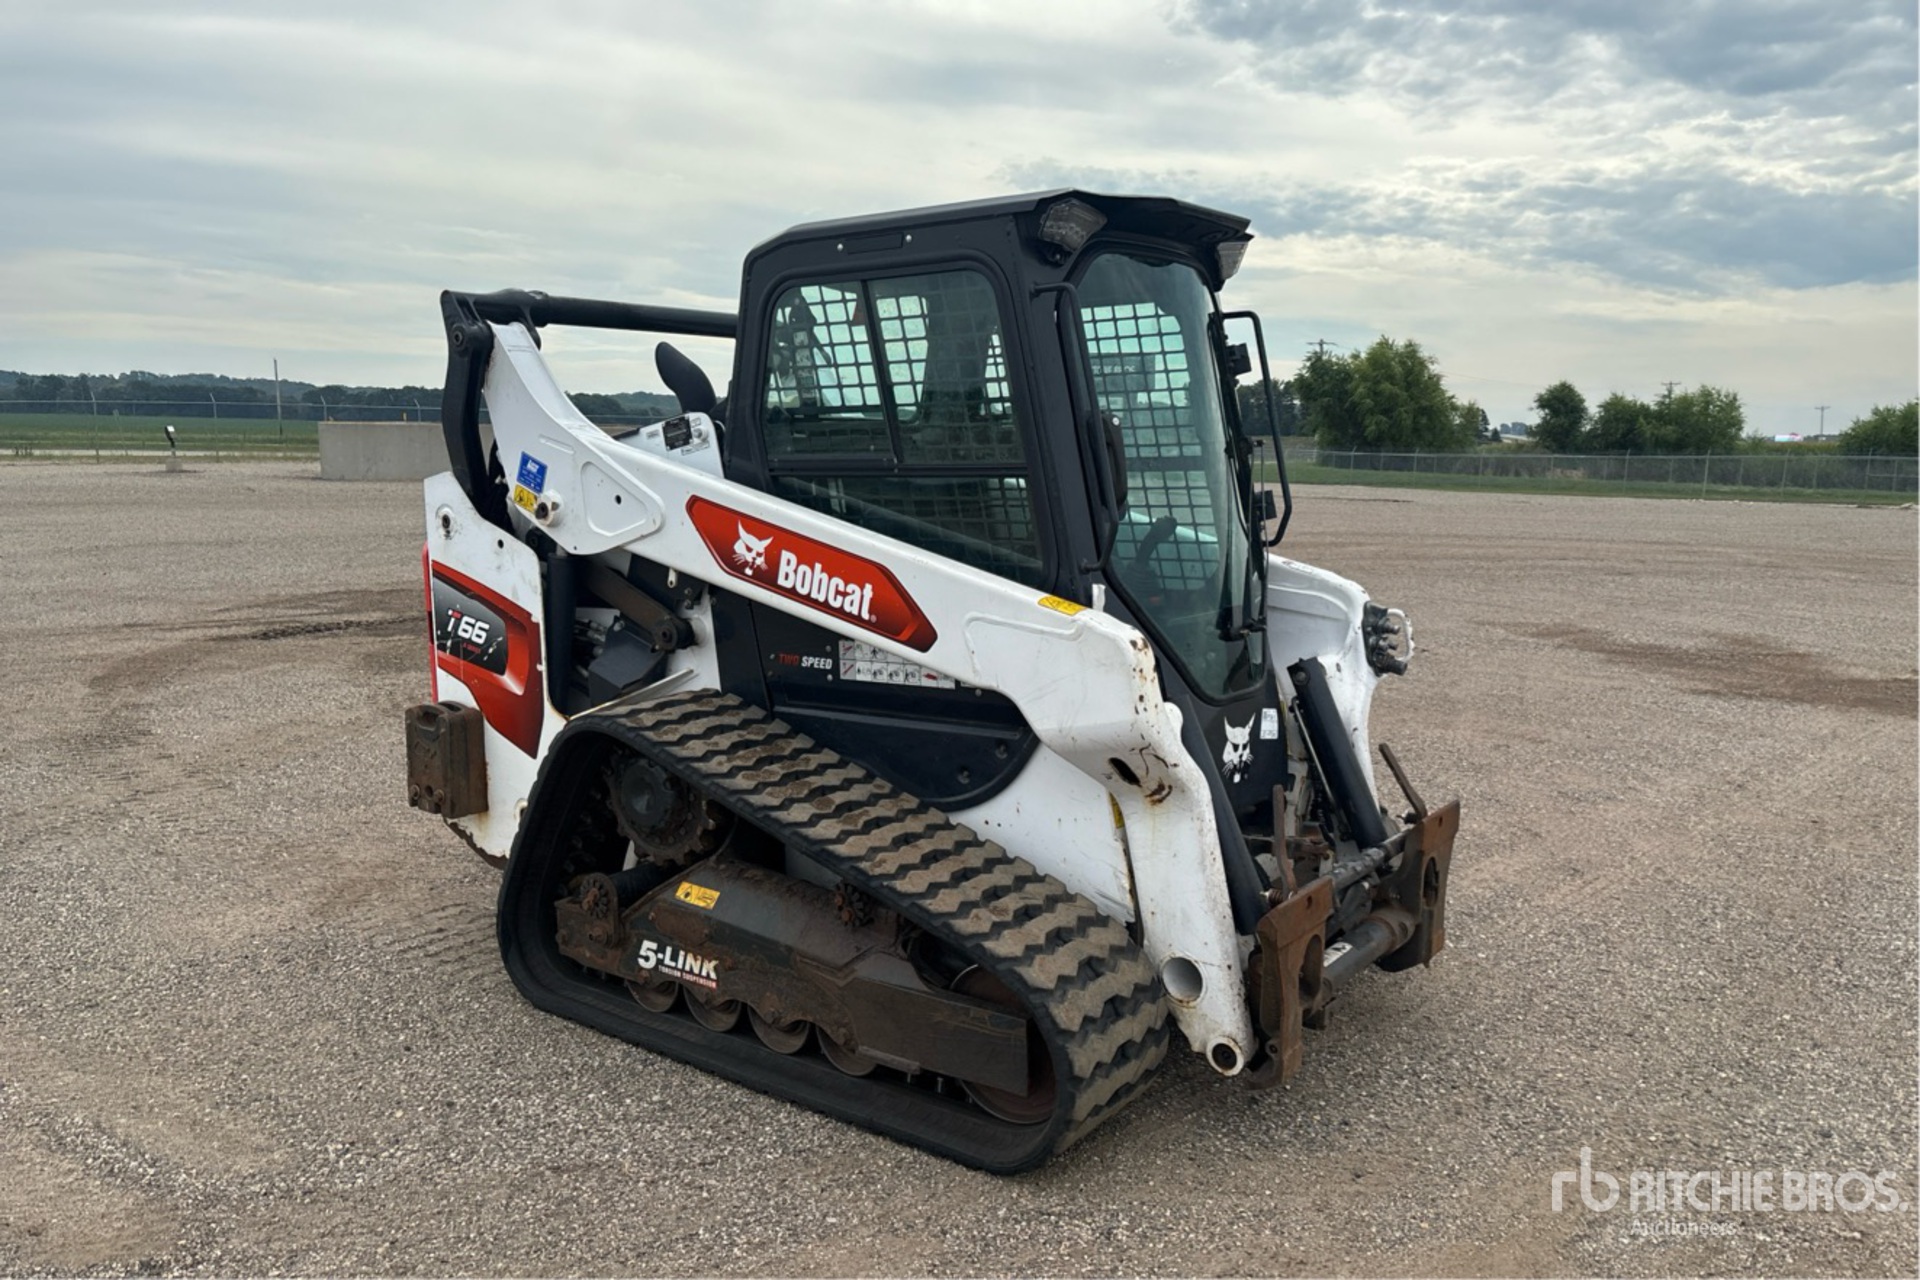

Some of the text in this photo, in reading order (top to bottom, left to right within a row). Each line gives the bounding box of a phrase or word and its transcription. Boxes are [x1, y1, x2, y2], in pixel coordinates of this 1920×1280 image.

[777, 549, 873, 621] Bobcat
[447, 609, 490, 645] T66
[778, 653, 833, 670] TWO SPEED
